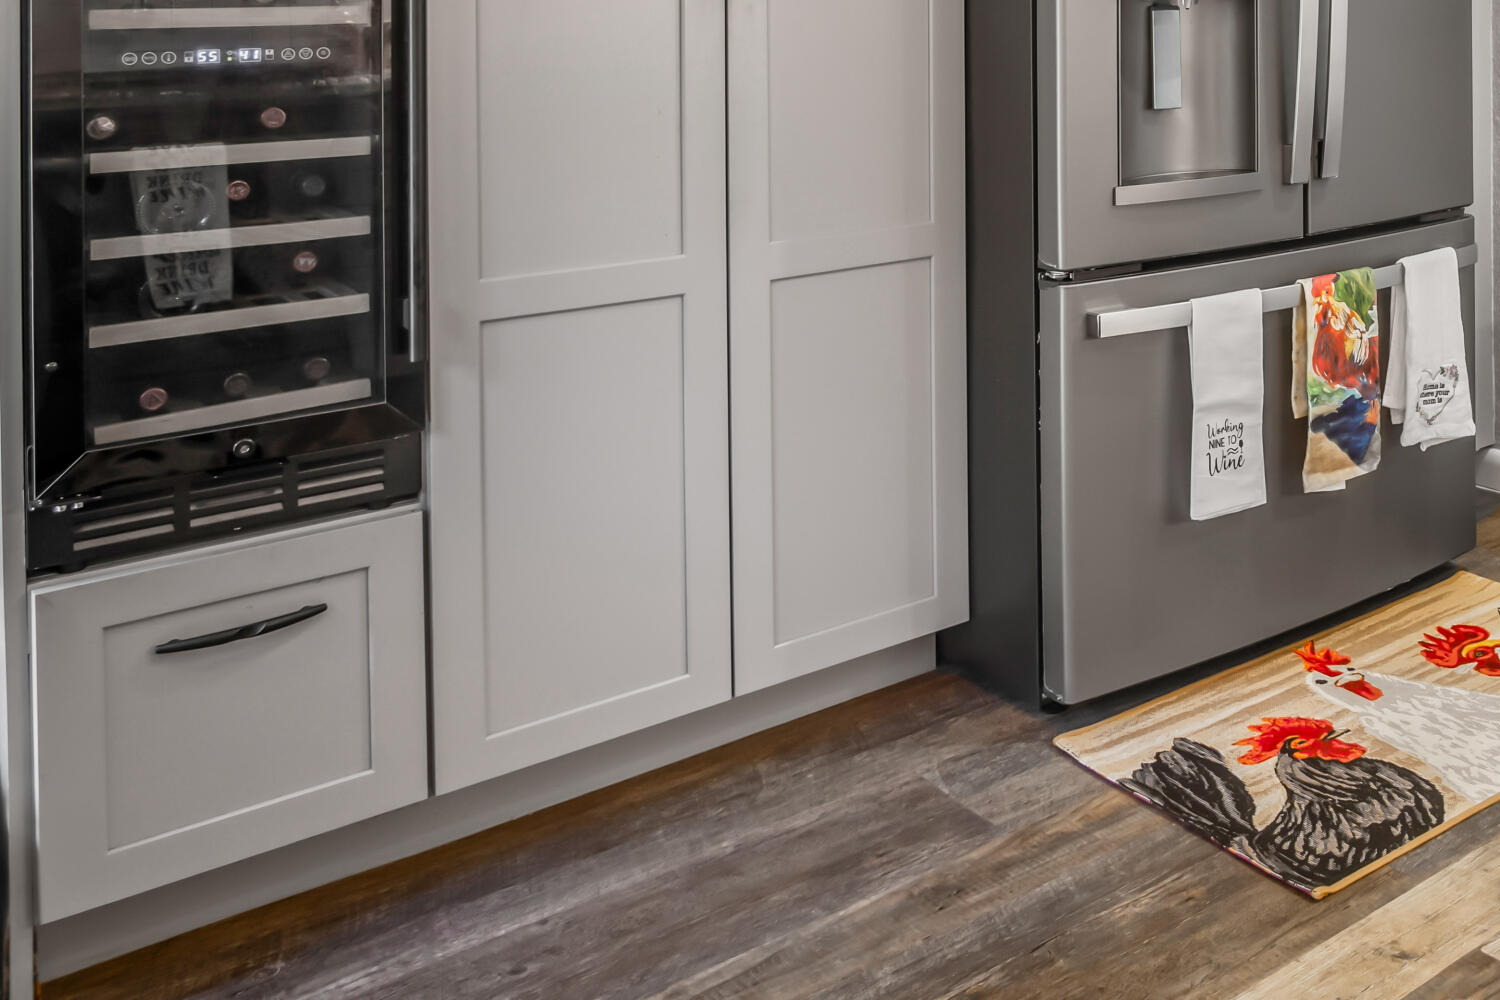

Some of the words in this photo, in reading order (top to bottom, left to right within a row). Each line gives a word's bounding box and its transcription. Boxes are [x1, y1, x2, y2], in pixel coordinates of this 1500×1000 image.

[198, 50, 218, 62] 55
[239, 50, 259, 61] 41
[1206, 418, 1244, 439] Working
[1209, 437, 1225, 449] NINE
[1228, 434, 1237, 445] TO
[1206, 449, 1246, 477] Wine
